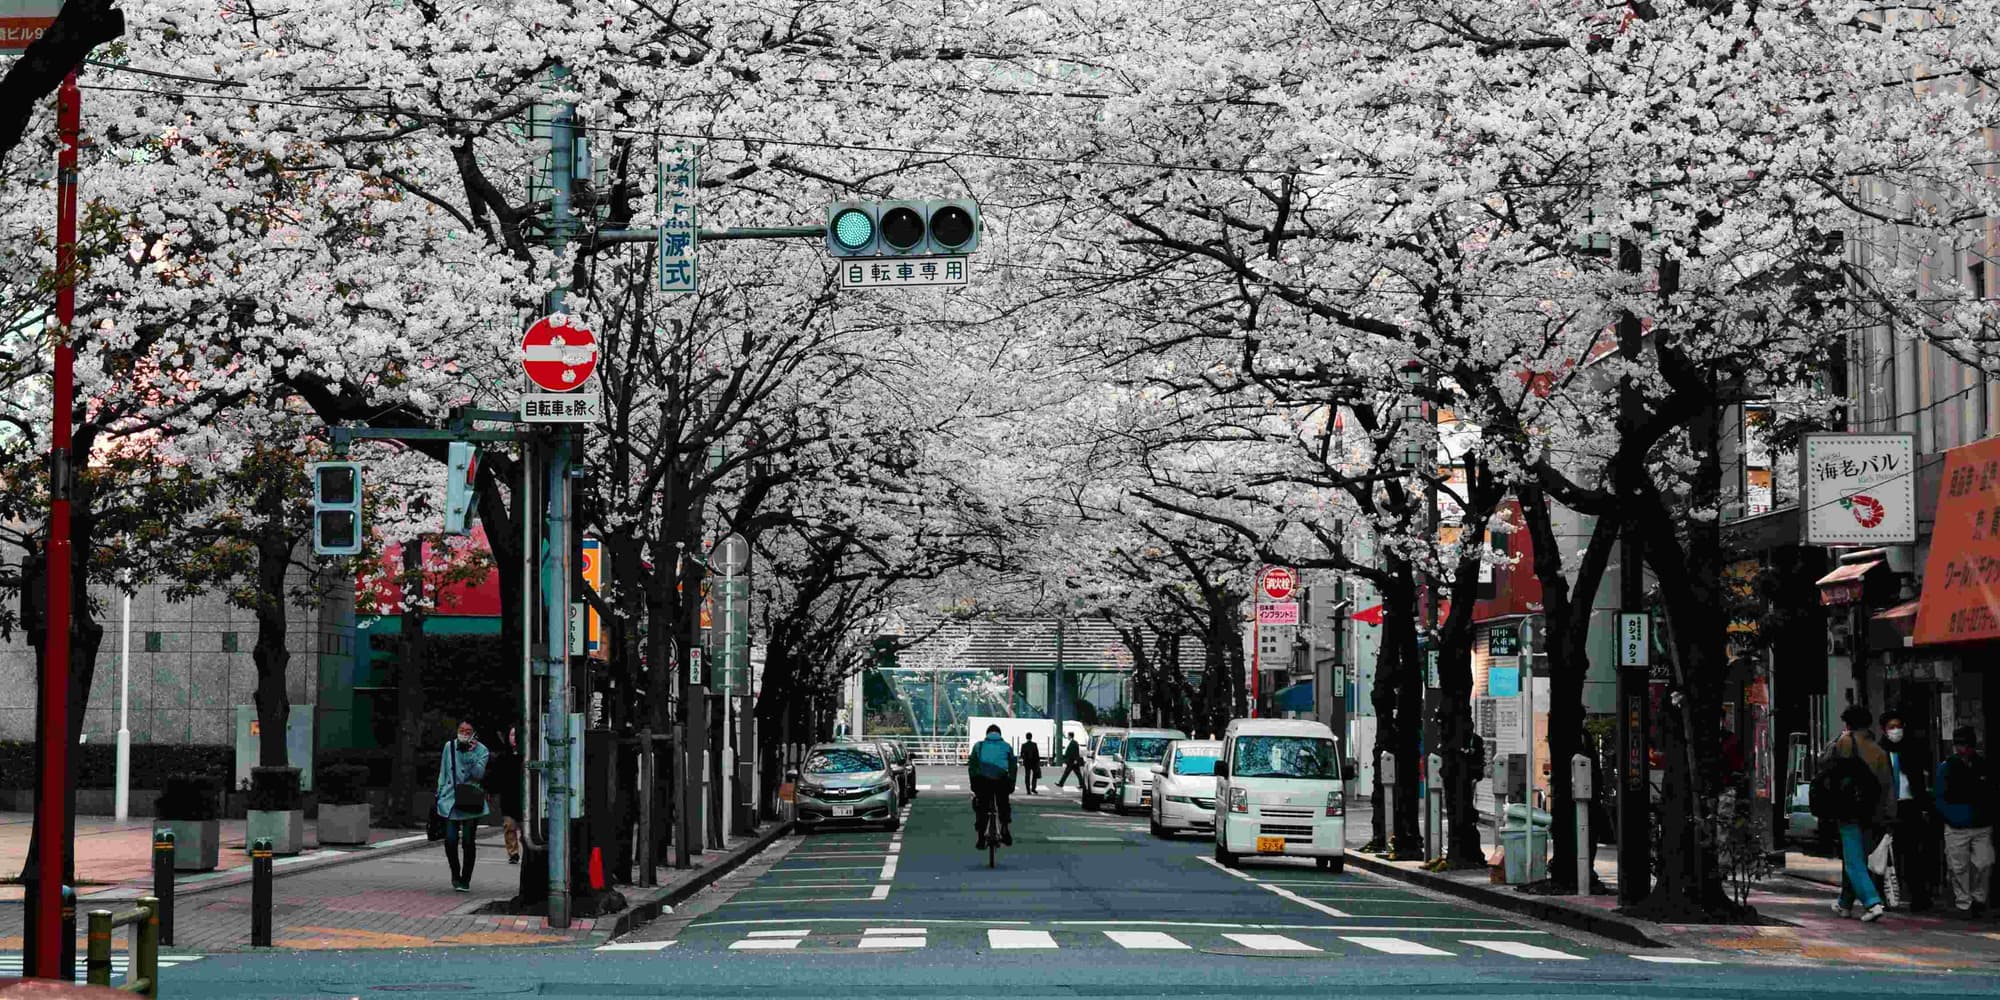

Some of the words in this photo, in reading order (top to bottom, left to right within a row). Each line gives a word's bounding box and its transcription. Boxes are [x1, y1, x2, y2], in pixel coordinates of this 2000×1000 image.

[849, 260, 963, 284] 自転車専用
[525, 400, 595, 417] 自転車を除く
[1816, 454, 1900, 481] 海老バル
[1265, 576, 1291, 590] 消火栓
